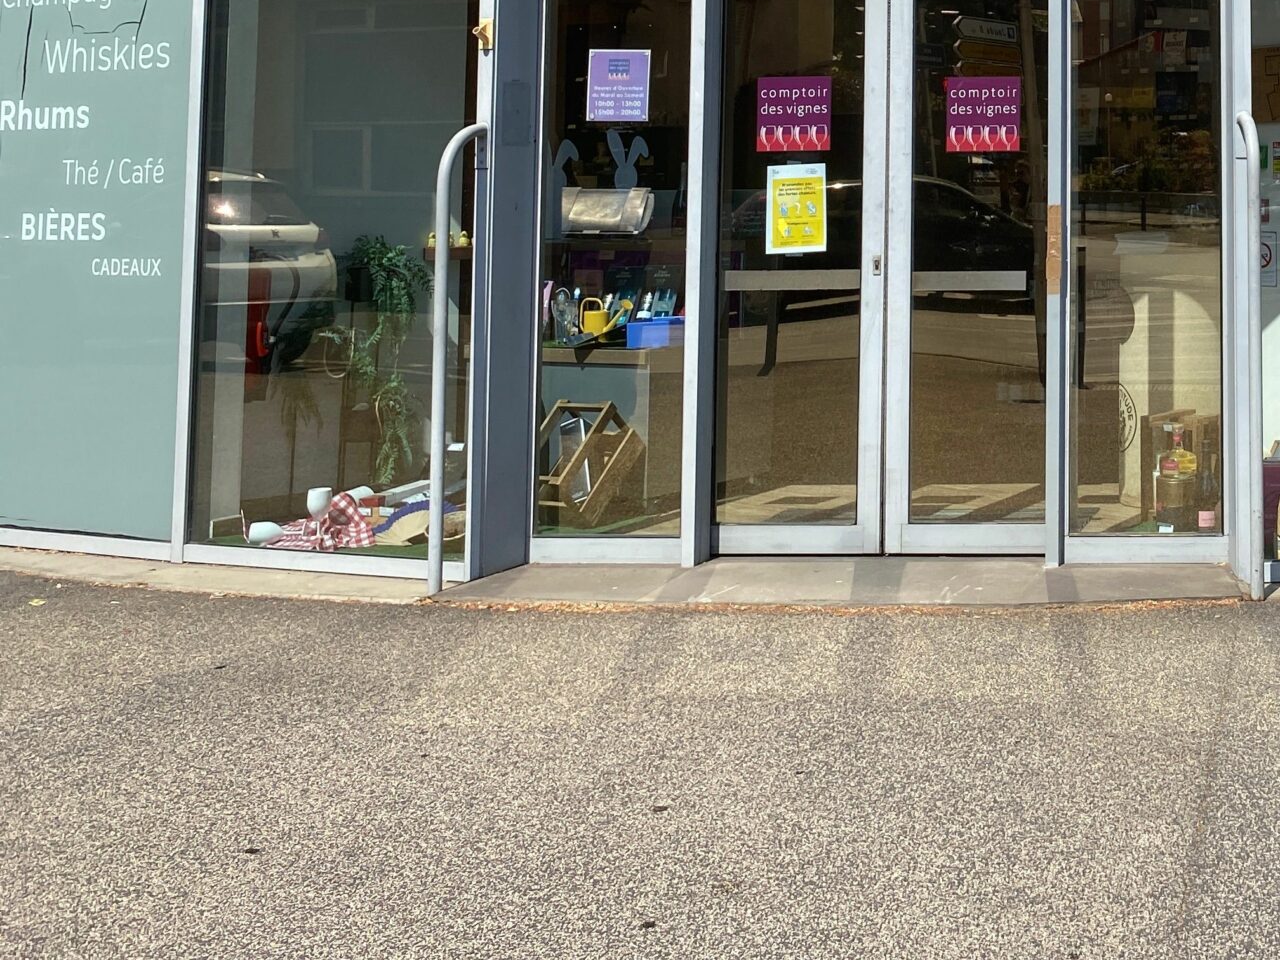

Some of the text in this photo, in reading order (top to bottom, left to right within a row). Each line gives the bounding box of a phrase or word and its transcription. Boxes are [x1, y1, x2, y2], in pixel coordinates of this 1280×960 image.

[45, 36, 170, 74] Whiskies
[761, 86, 828, 100] comptoir
[950, 86, 1017, 100] comptoir
[0, 100, 90, 131] Rhums
[761, 103, 828, 117] des vignes
[950, 103, 1017, 117] des vignes
[63, 158, 165, 189] Thé / Café
[21, 207, 106, 241] BIÈRES
[92, 258, 161, 276] CADEAUX
